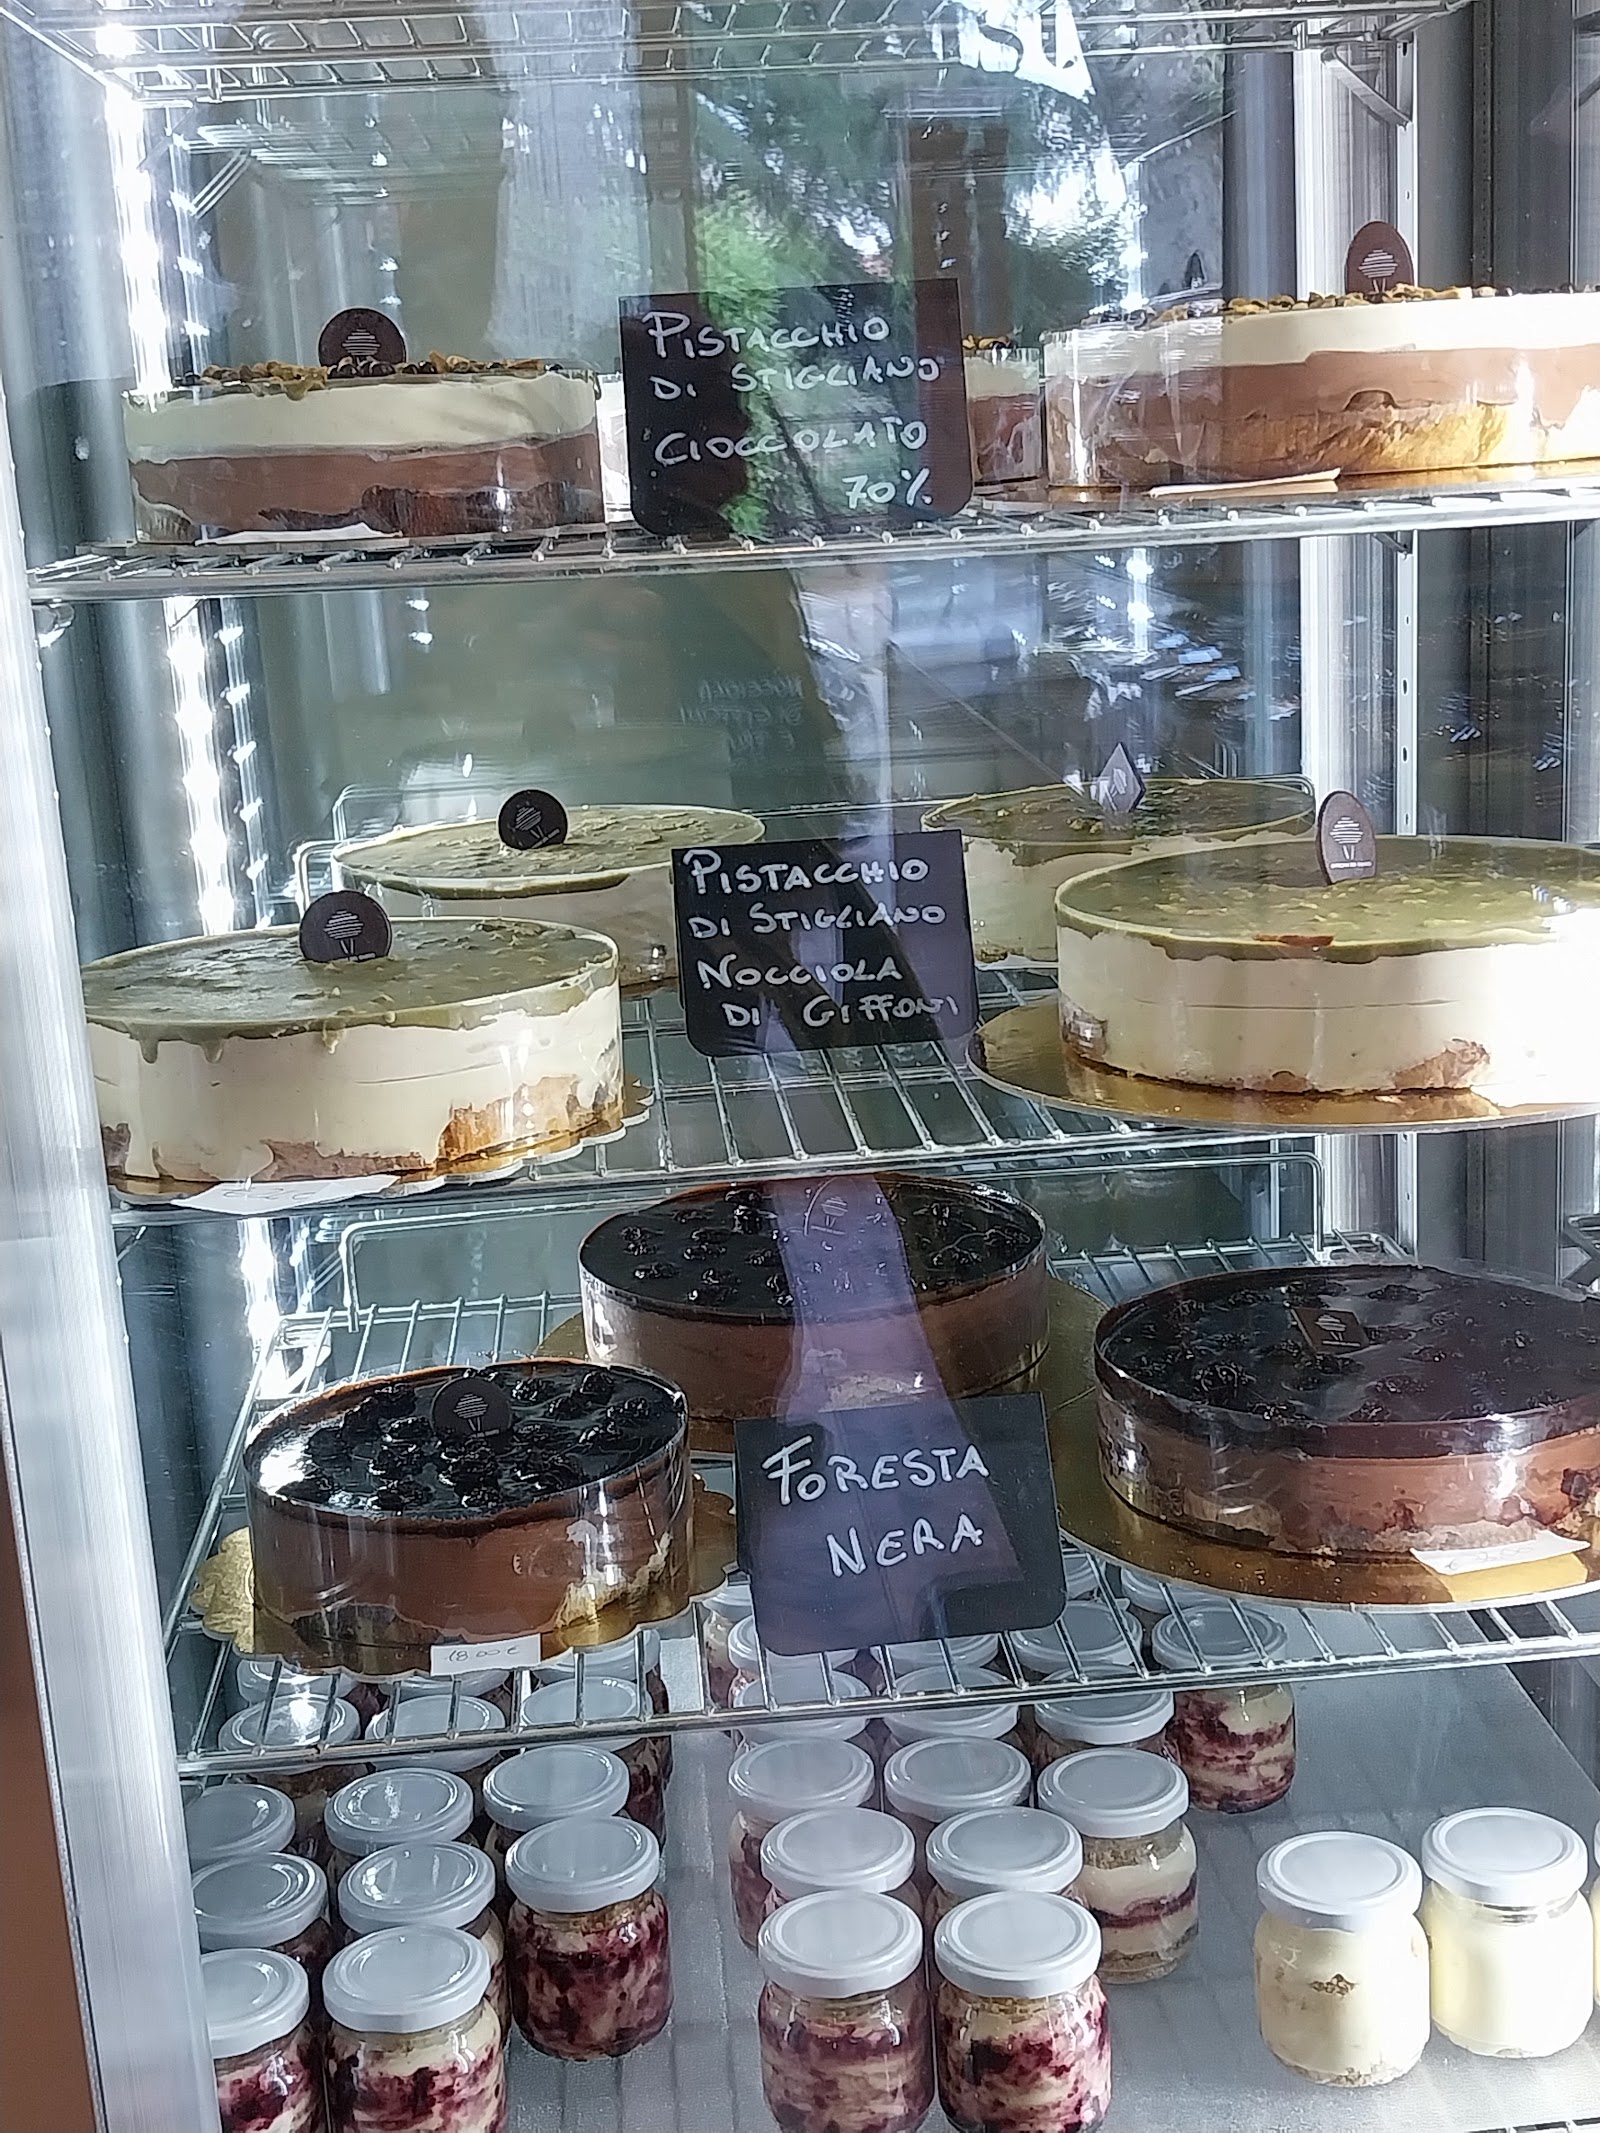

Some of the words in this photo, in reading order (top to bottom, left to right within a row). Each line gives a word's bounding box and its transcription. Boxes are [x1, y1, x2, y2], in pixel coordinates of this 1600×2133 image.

[642, 311, 890, 358] PISTACCHIO
[650, 376, 697, 399] DI
[731, 355, 940, 391] STIGLIANO
[655, 416, 927, 466] CIOCCOLATO
[843, 467, 933, 508] 70%
[683, 849, 929, 894] PISTACCHIO
[688, 917, 730, 938] DI
[750, 902, 946, 933] STIGLIANO
[697, 954, 903, 989] NOCCIOLA
[722, 1002, 760, 1027] DI
[803, 994, 959, 1027] GIFFONI
[762, 1435, 990, 1505] FORESTA
[827, 1513, 983, 1577] NERA
